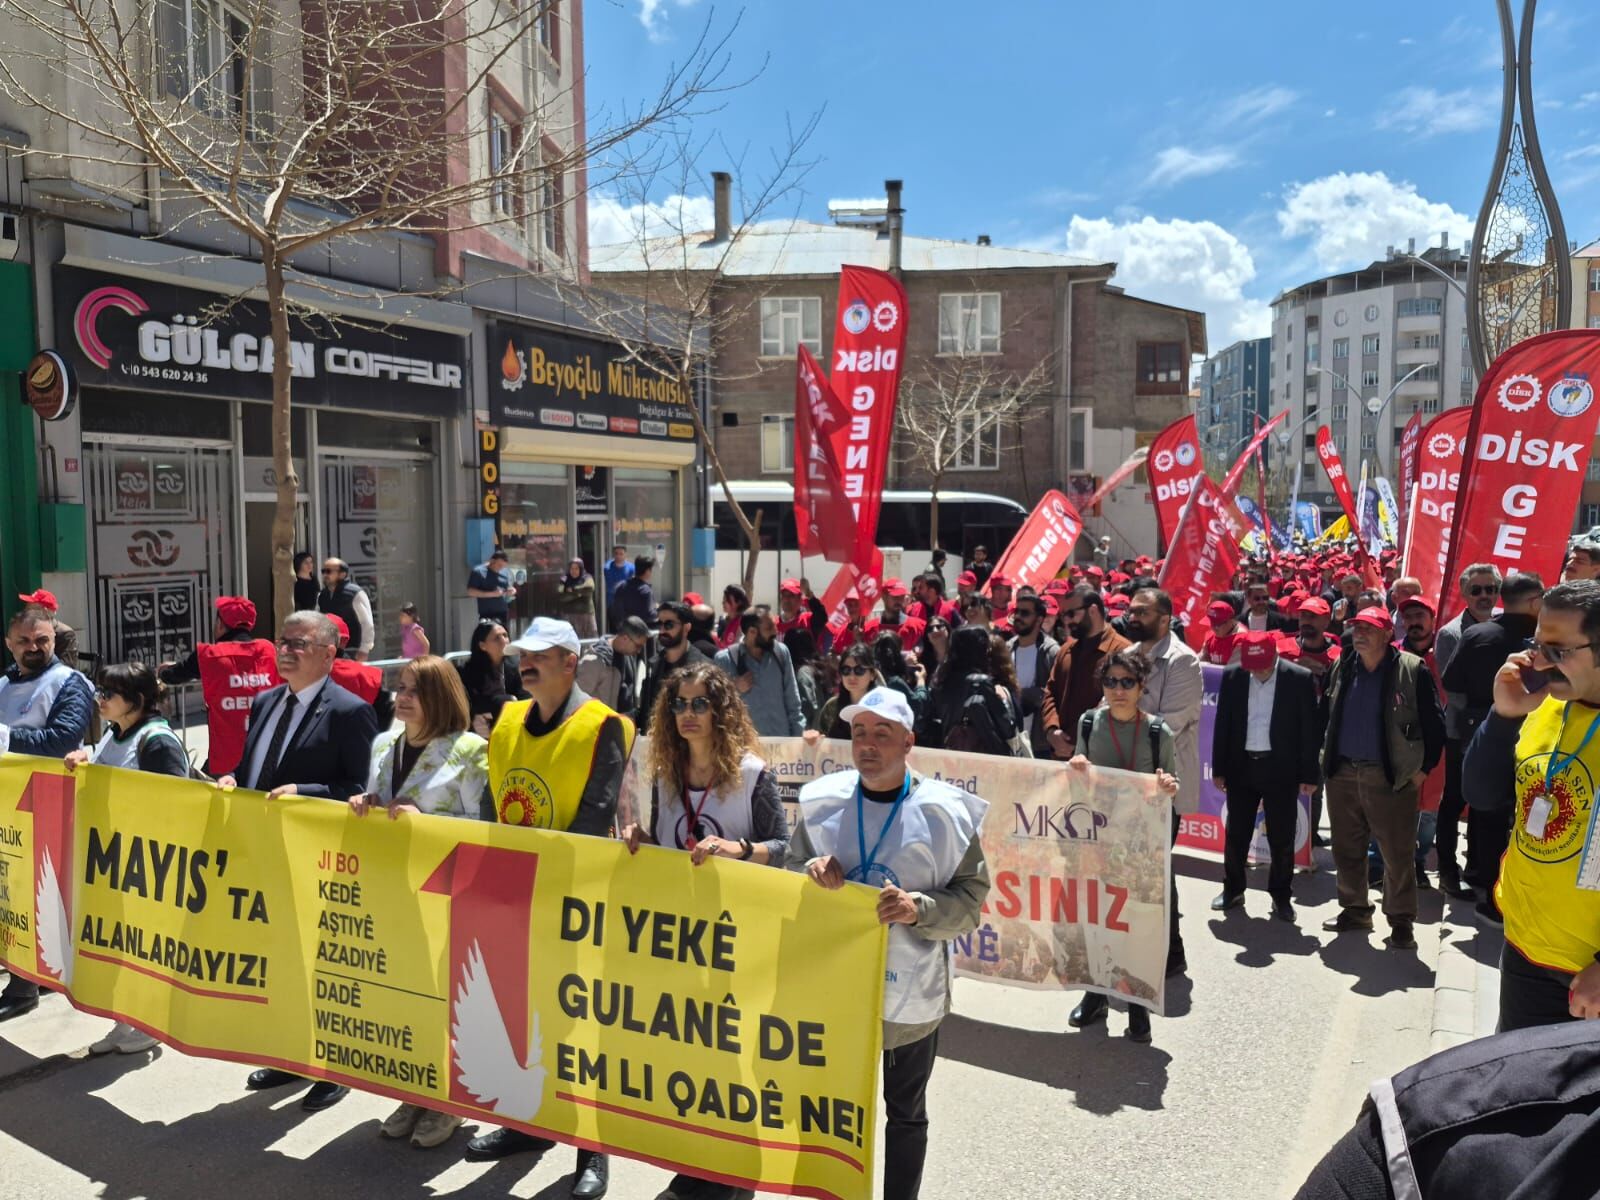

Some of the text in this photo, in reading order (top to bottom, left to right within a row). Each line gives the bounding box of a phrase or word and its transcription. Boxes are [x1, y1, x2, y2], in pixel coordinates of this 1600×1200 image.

[133, 365, 208, 384] 0 543 620 24 36
[325, 347, 462, 389] COIFFEUR
[1478, 430, 1585, 471] DİSK
[1421, 469, 1461, 491] DİS
[1493, 484, 1537, 580] GE
[229, 672, 271, 688] DİSK
[318, 850, 360, 876] JI BO
[318, 879, 361, 907] KEDÊ
[979, 870, 1130, 934] SINIZ
[317, 909, 375, 941] AŞTIYÊ
[560, 895, 737, 972] DI YEKÊ
[80, 913, 268, 988] ALANLARDAYIZ!
[316, 940, 387, 974] AZADIYÊ
[315, 978, 362, 1009] DADÊ
[315, 1008, 413, 1052] WEKHEVIYÊ
[557, 973, 827, 1067] GULANÊ DE
[315, 1039, 438, 1090] DEMOKRASIYÊ
[557, 1042, 865, 1149] EM LI QADÊ NE!
